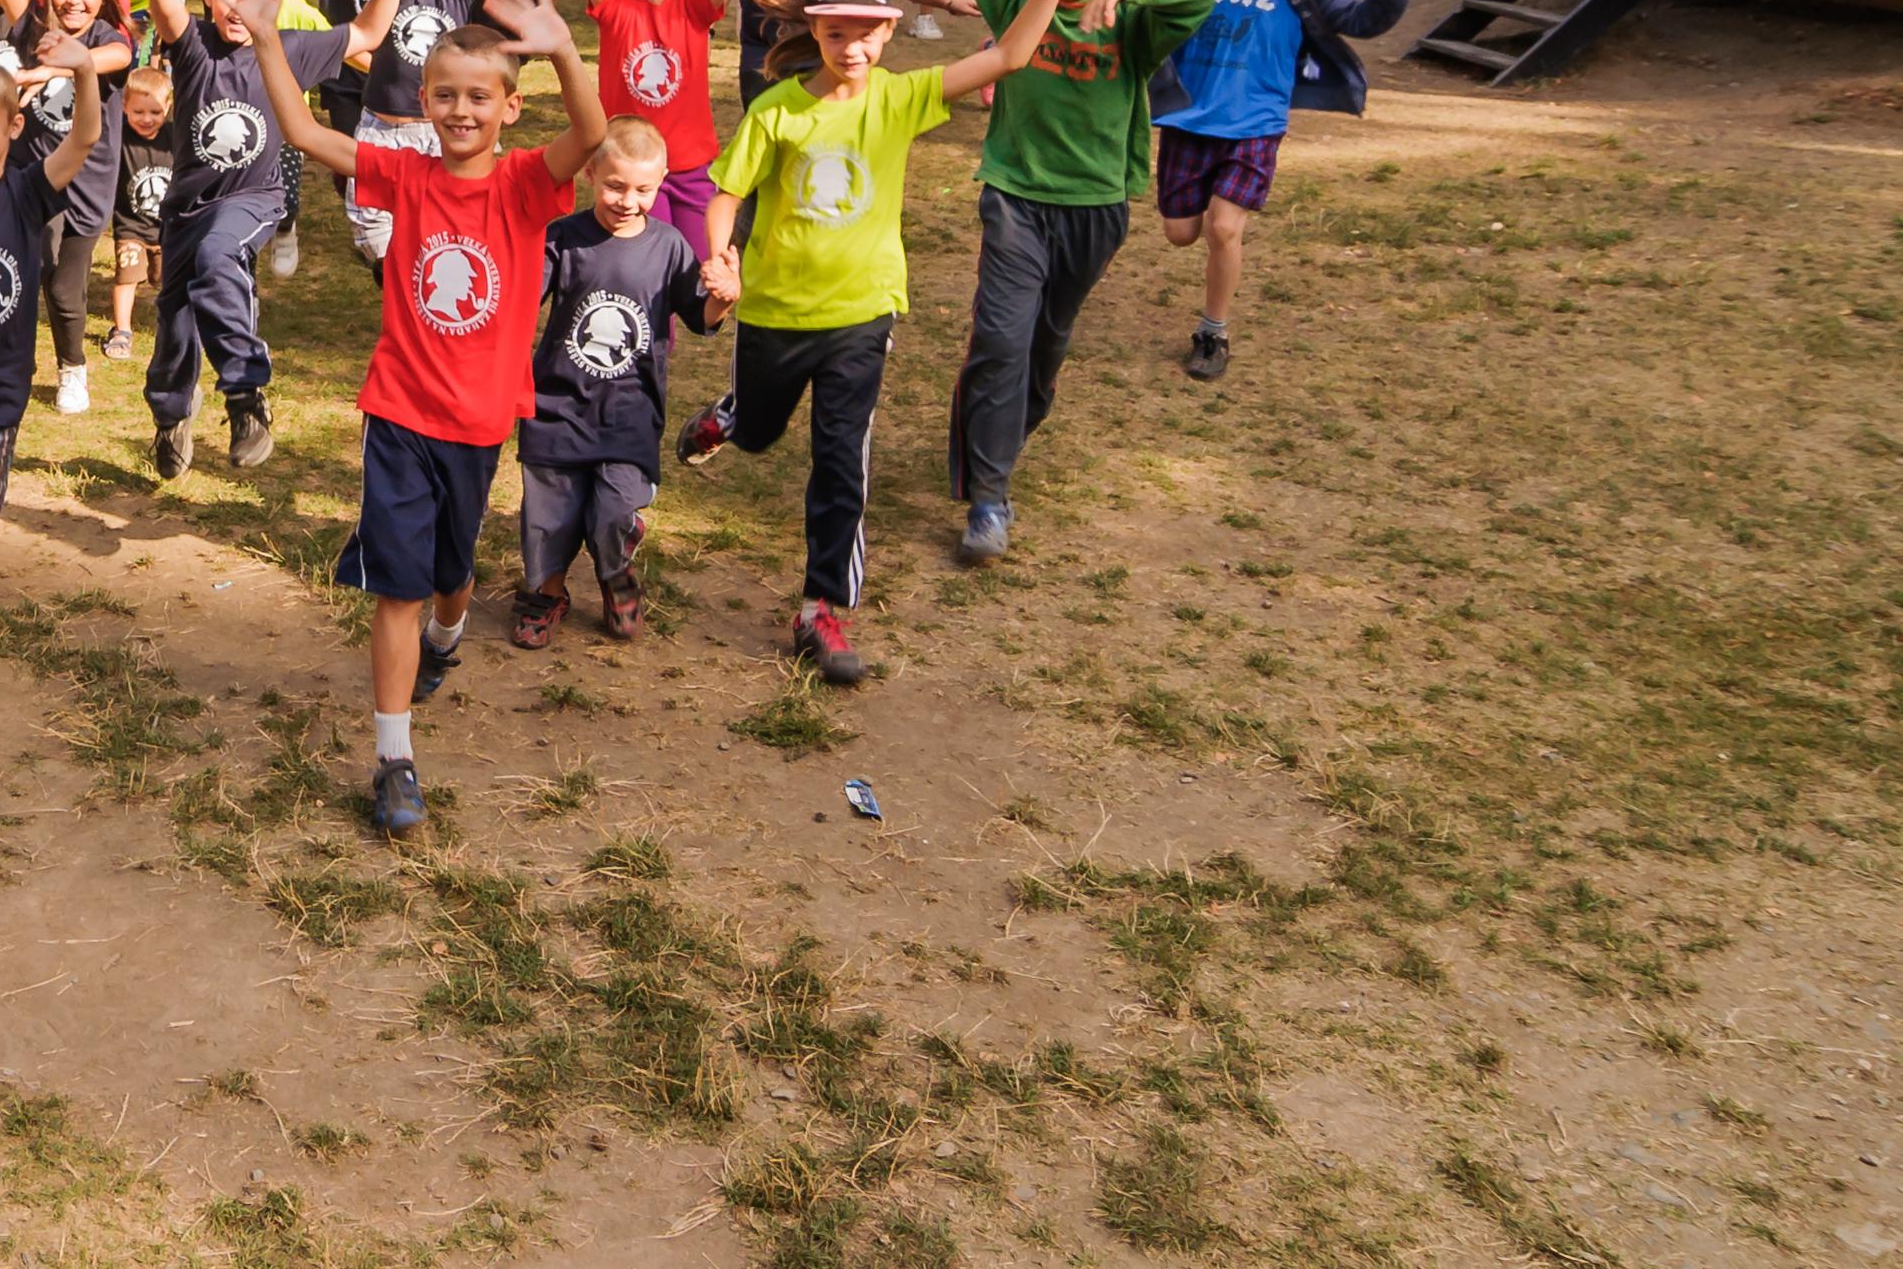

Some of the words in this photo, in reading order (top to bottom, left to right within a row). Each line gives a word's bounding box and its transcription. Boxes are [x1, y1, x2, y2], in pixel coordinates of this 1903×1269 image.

[425, 230, 450, 249] 2015
[457, 234, 489, 255] VELKÁ
[586, 289, 607, 306] 2015
[432, 320, 447, 336] NA
